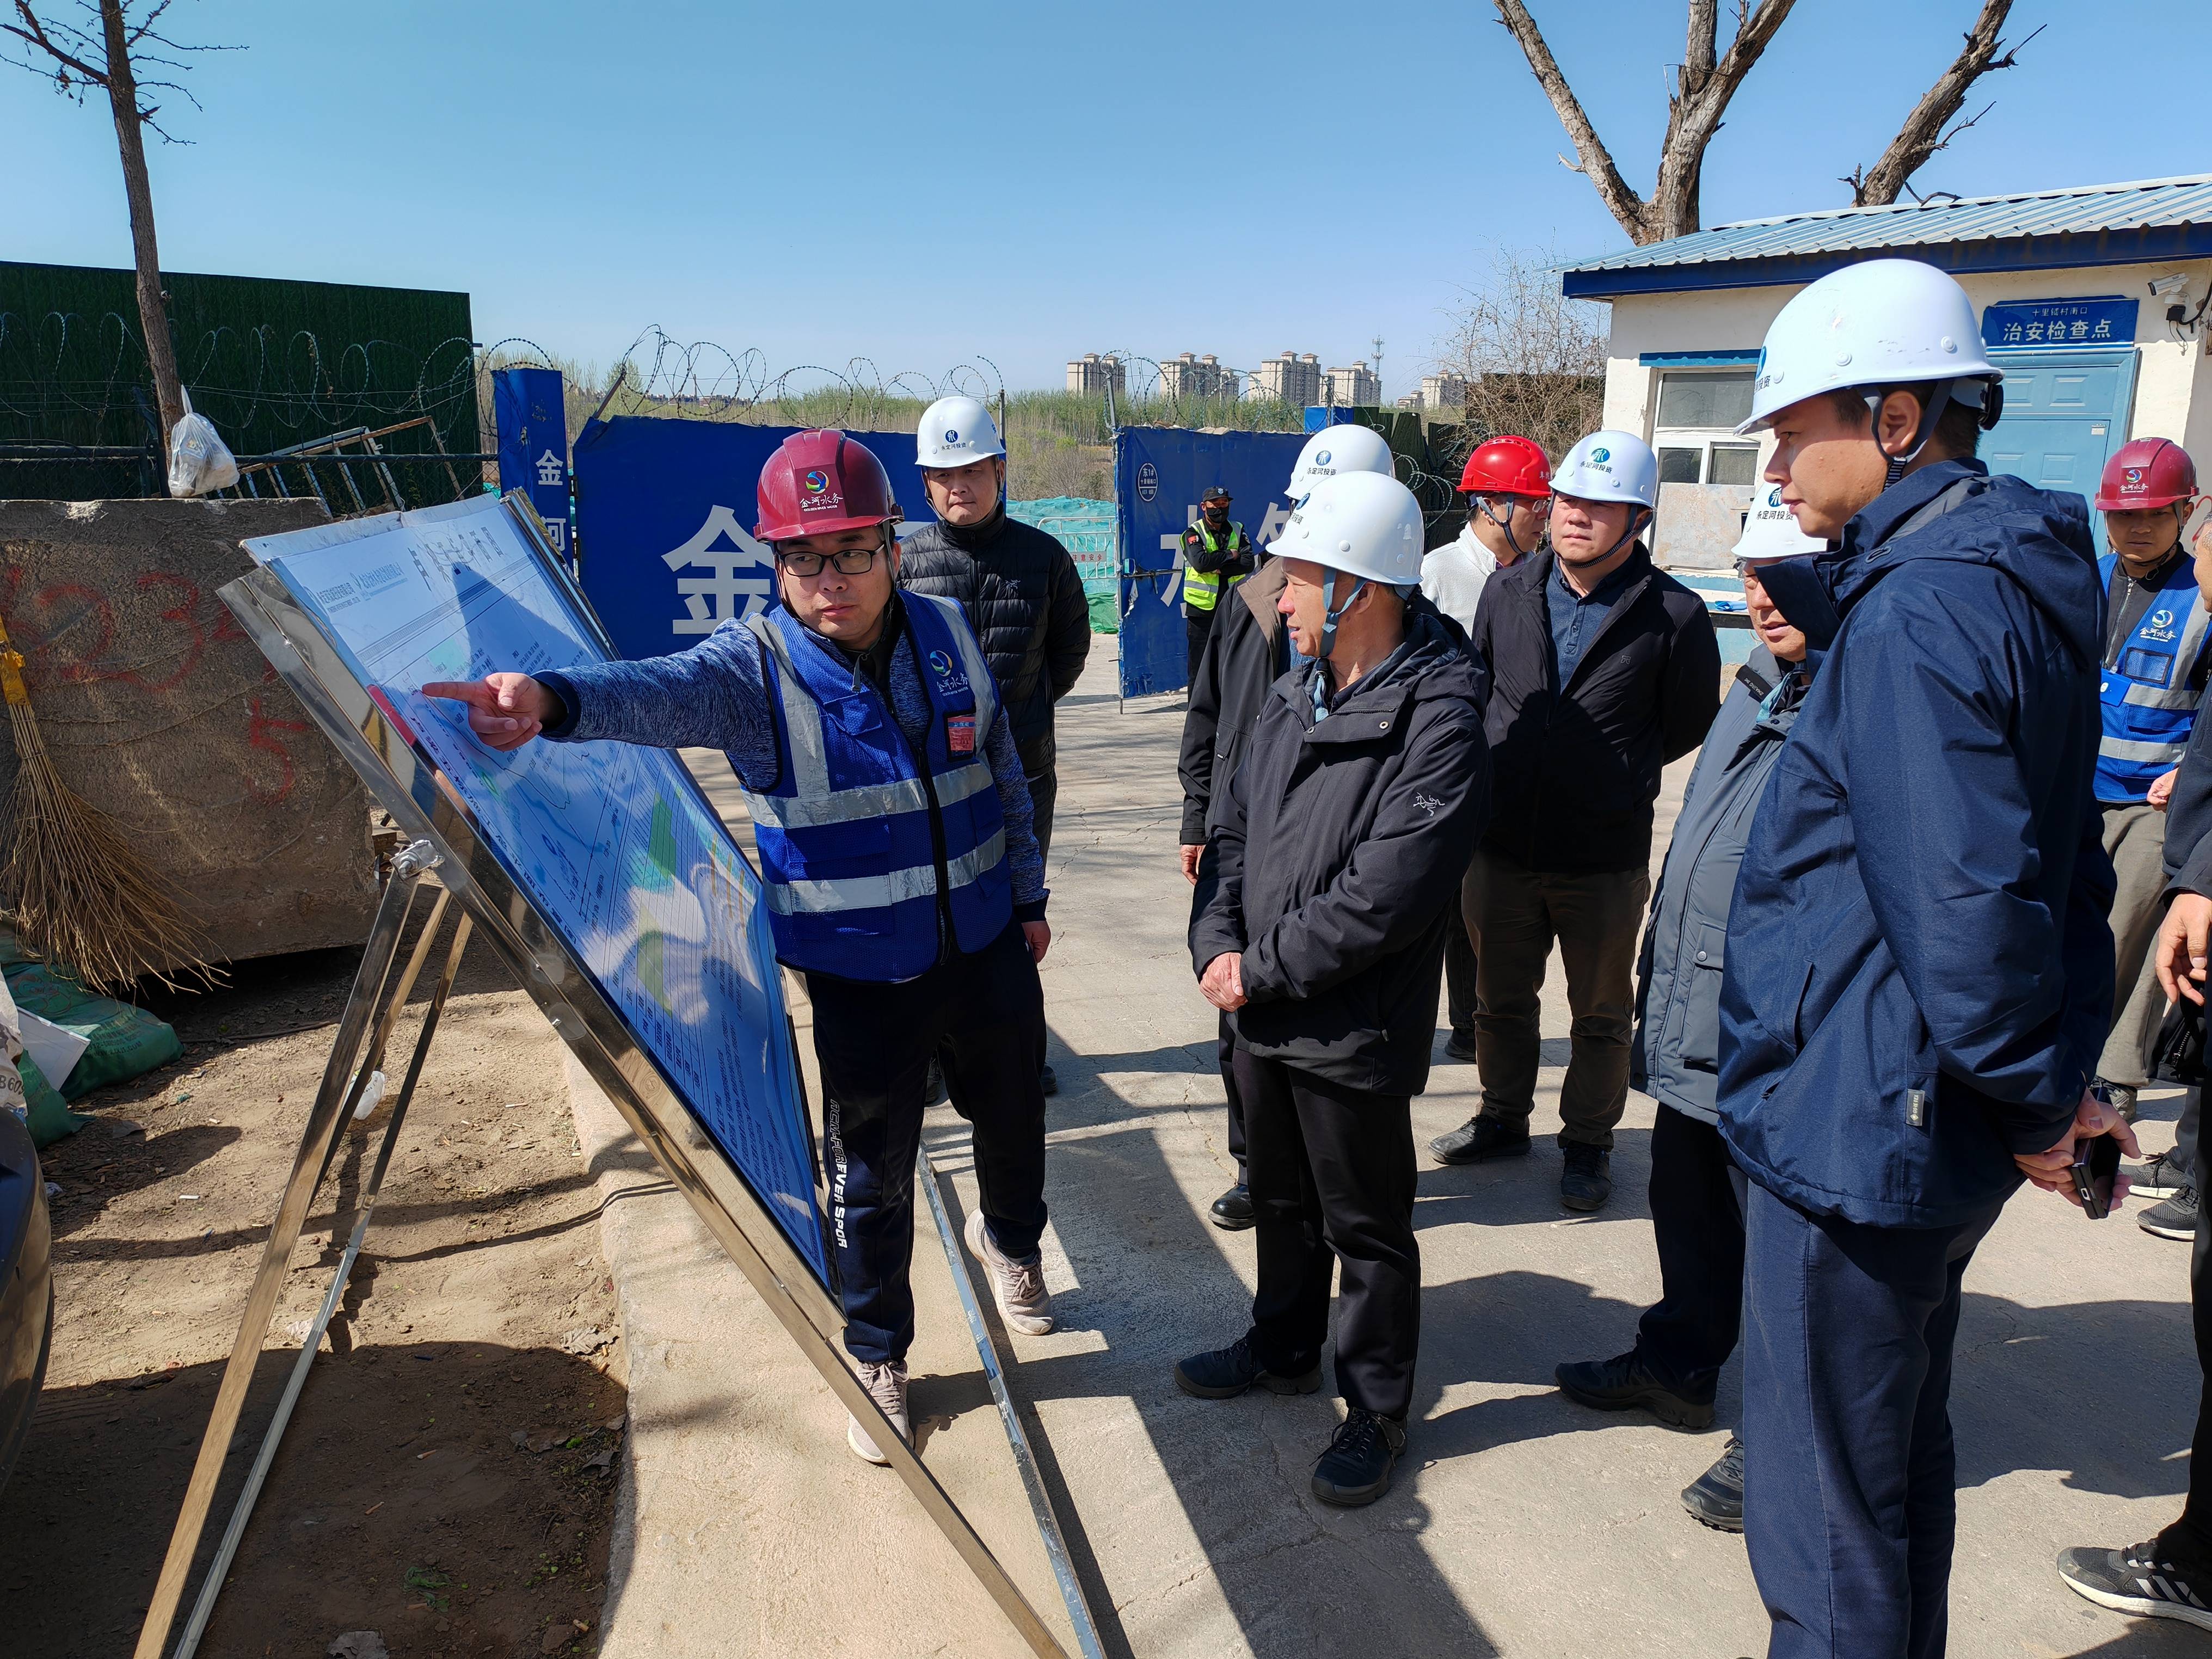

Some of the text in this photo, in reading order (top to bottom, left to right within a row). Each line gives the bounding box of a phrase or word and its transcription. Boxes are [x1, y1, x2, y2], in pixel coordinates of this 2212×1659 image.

[2003, 319, 2111, 341] 治安检查点
[1580, 461, 1613, 474] 永定河投资
[2120, 483, 2149, 491] 金河水务
[800, 492, 844, 508] 金河水务
[1756, 511, 1793, 520] 永定河投资
[2140, 627, 2177, 640] 金河水务
[937, 672, 968, 692] 金河水务
